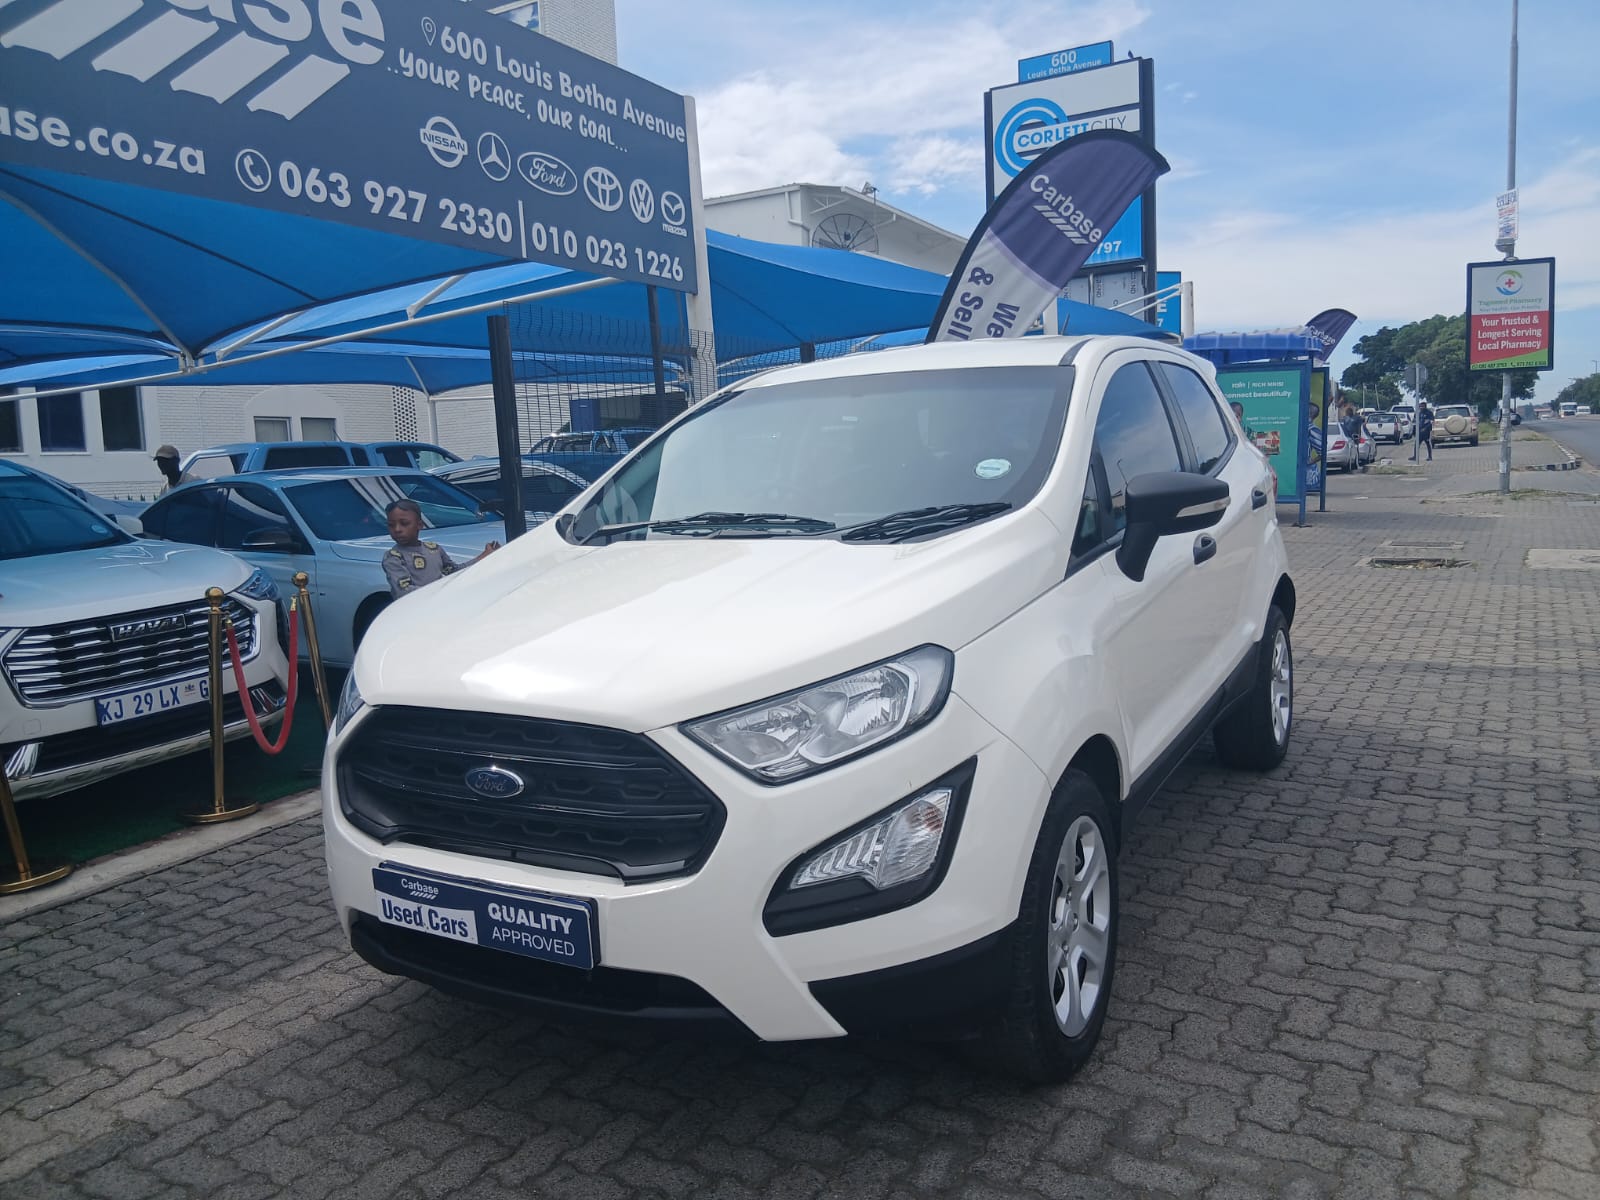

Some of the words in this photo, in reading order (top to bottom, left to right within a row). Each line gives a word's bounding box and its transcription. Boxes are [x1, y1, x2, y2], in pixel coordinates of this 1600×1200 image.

[1027, 70, 1047, 80] Louis
[1073, 58, 1102, 71] Avenue
[1051, 50, 1077, 67] 600
[441, 26, 487, 65] 600
[496, 45, 553, 91] Louis
[558, 71, 617, 116] Botha
[623, 98, 685, 142] Avenue
[468, 74, 530, 119] PEACE,
[537, 99, 573, 130] OUR
[423, 131, 465, 151] NISSAN
[529, 158, 566, 188] Ford
[278, 160, 352, 208] 063
[364, 180, 428, 224] 927
[438, 197, 513, 243] 2330
[1030, 174, 1102, 243] Carbase
[532, 222, 578, 259] 010
[586, 235, 628, 270] 023
[635, 247, 684, 282] 1226
[968, 267, 994, 285] &
[947, 292, 984, 340] Sell
[987, 303, 1020, 338] We
[1481, 317, 1498, 327] Your
[1501, 316, 1530, 326] Trusted
[1532, 315, 1539, 324] &
[1478, 329, 1509, 340] Longest
[1511, 328, 1542, 338] Serving
[1478, 341, 1499, 350] Local
[1501, 340, 1541, 350] Pharmacy
[1253, 390, 1292, 399] beautifully
[119, 618, 183, 636] HAVAL
[102, 699, 124, 722] KJ
[133, 692, 153, 715] 29
[160, 686, 180, 709] LX
[474, 774, 506, 793] Ford
[401, 878, 439, 895] Carbase
[381, 898, 424, 927] Used
[428, 909, 468, 938] Cars
[487, 903, 573, 934] QUALITY
[492, 926, 575, 956] APPROVED
